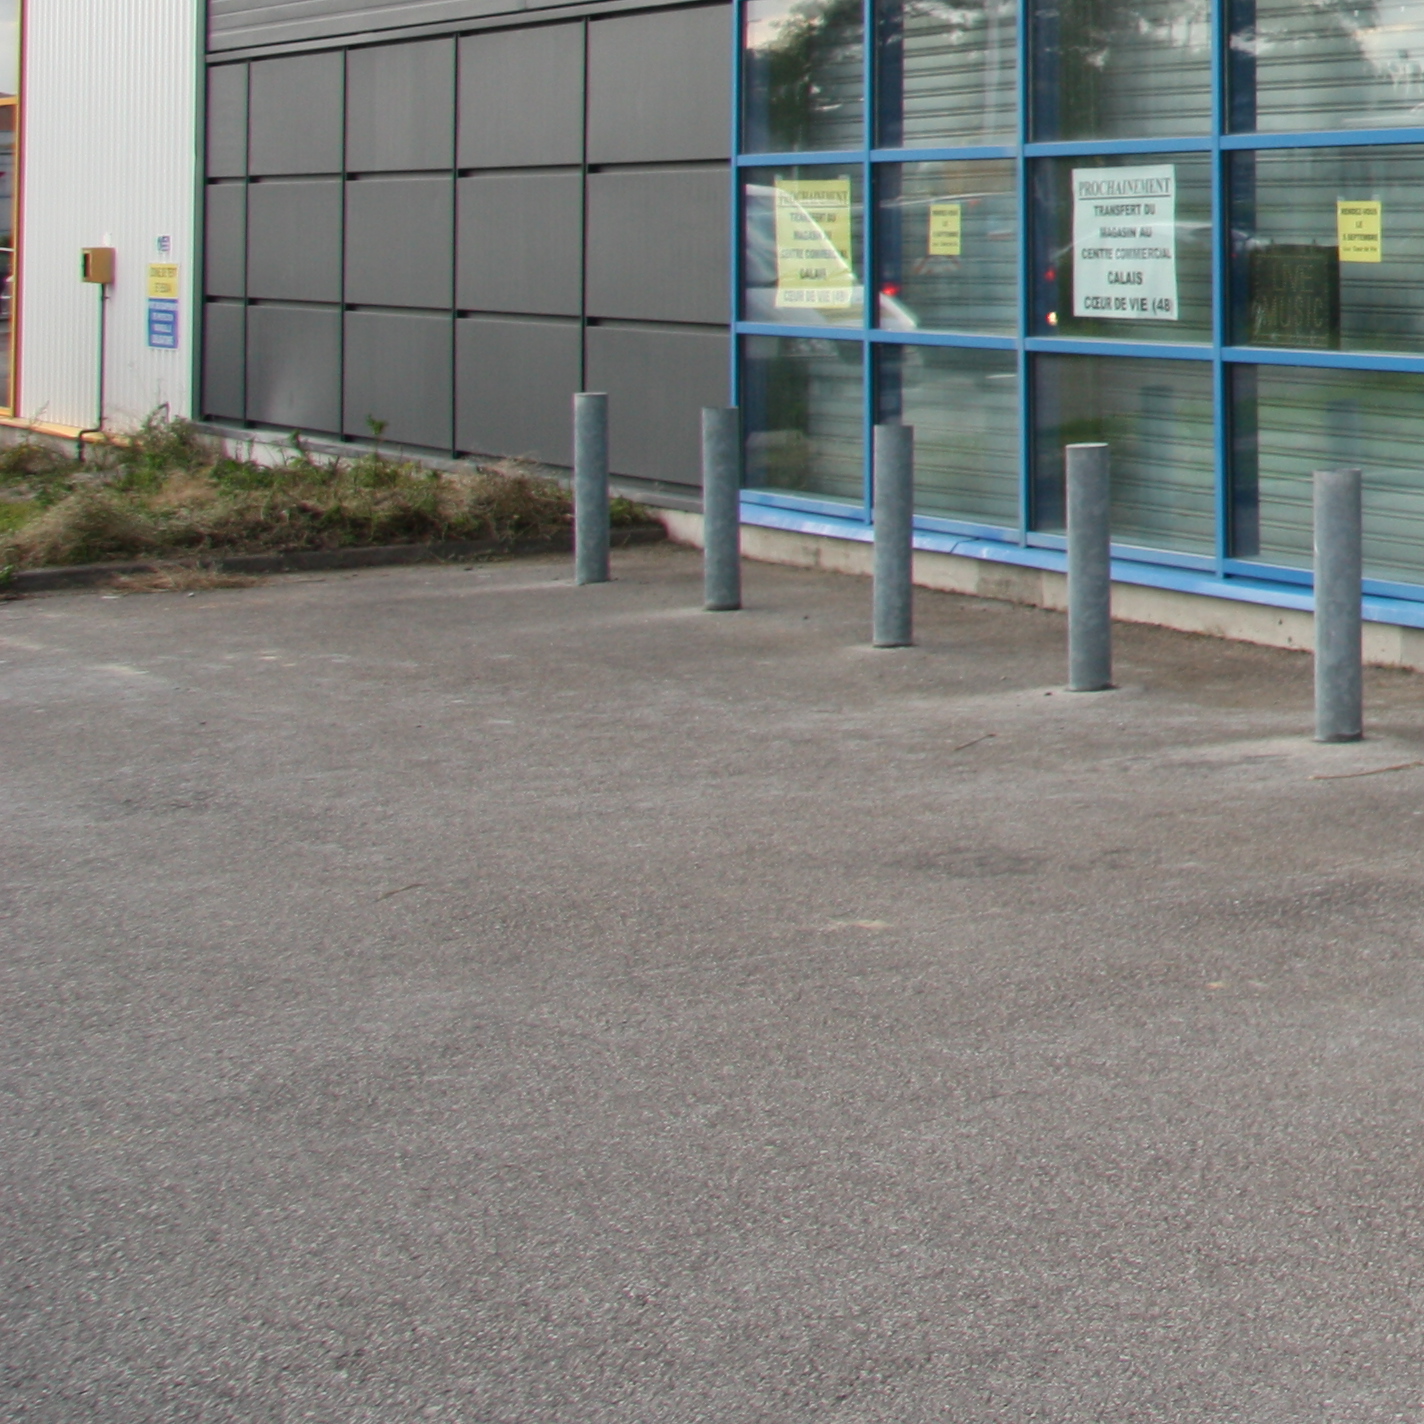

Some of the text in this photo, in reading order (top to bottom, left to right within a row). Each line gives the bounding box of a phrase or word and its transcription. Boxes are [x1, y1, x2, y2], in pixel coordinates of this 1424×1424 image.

[1078, 178, 1171, 197] PROCHAINEMENT
[1093, 204, 1156, 216] TRANSFERT DU
[1107, 271, 1143, 285] CALAIS
[1114, 296, 1127, 311] DE
[1129, 297, 1148, 312] VIE
